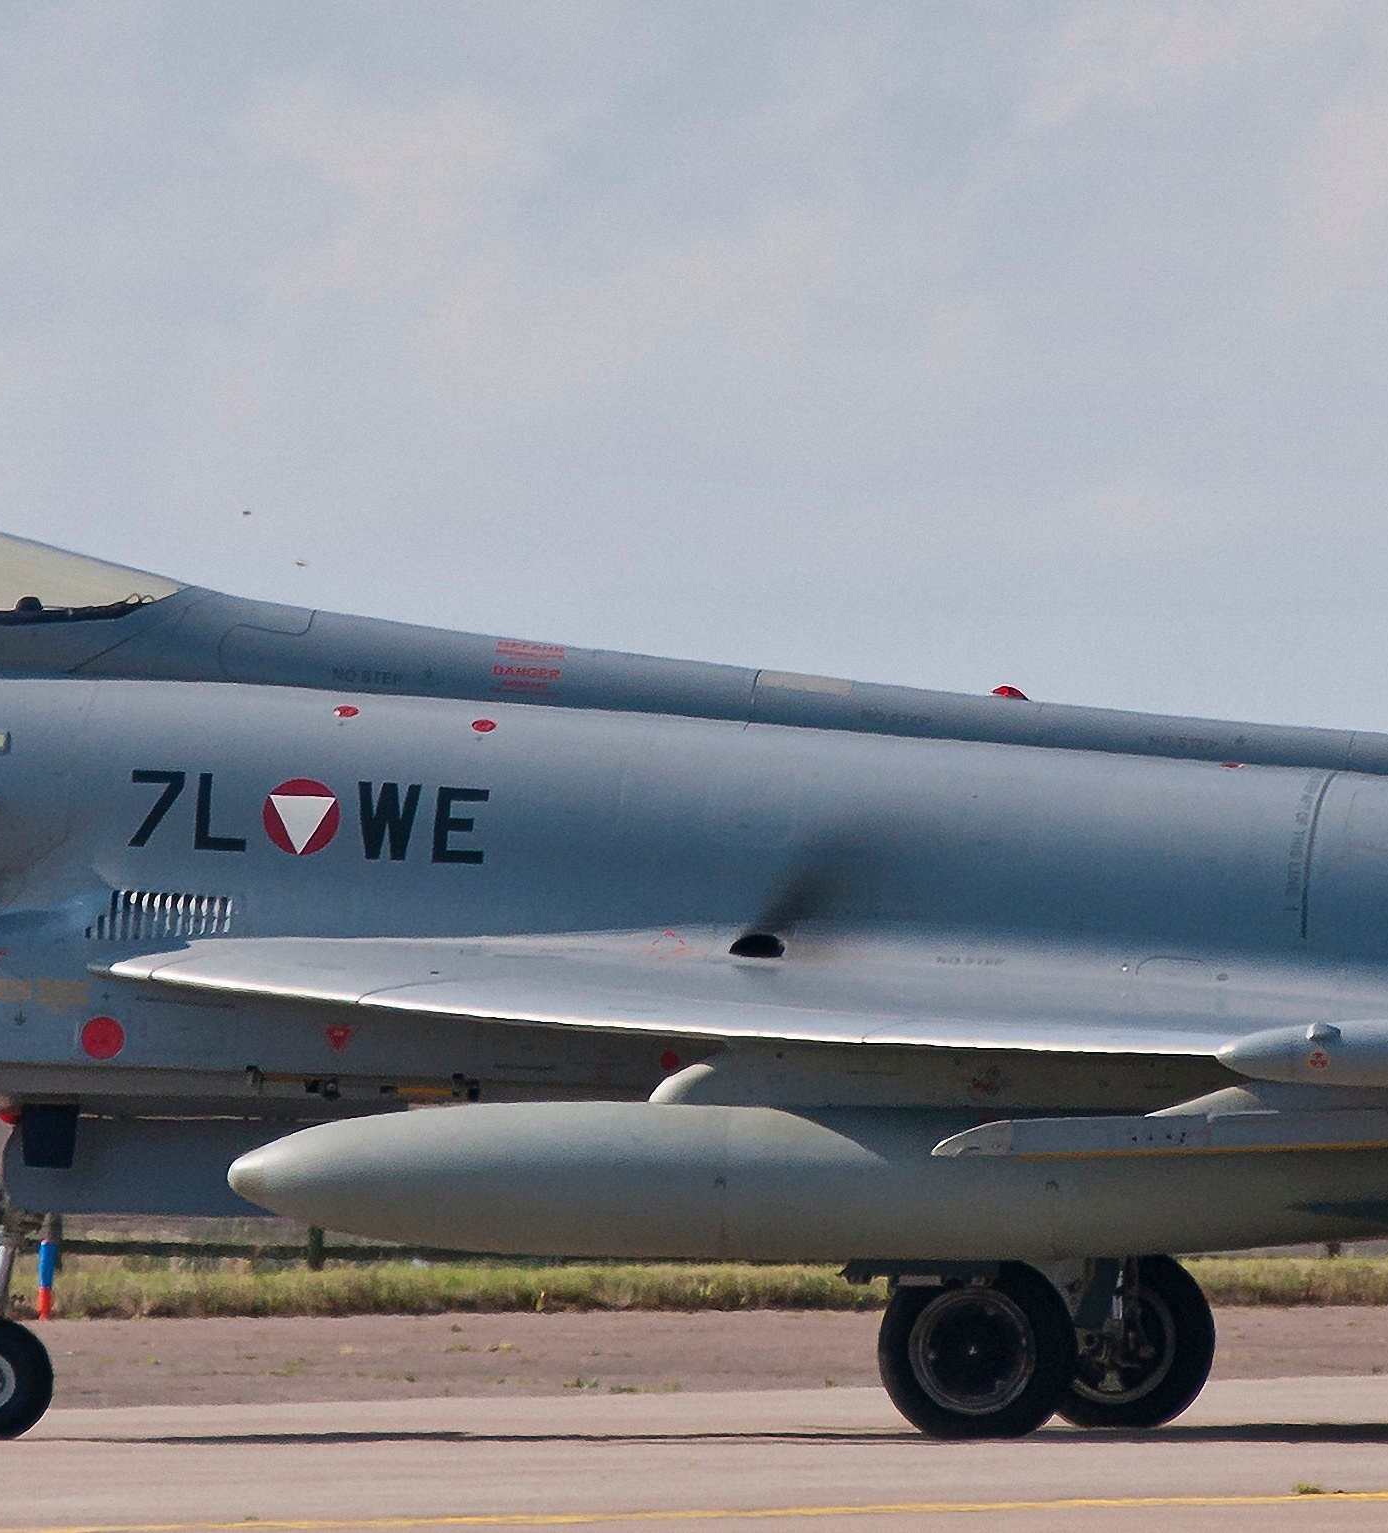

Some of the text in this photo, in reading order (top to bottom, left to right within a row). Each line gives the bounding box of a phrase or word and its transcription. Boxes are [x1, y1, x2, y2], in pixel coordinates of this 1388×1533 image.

[332, 667, 402, 686] NO STEP
[492, 664, 561, 680] DANGER
[127, 769, 490, 864] 7L WE
